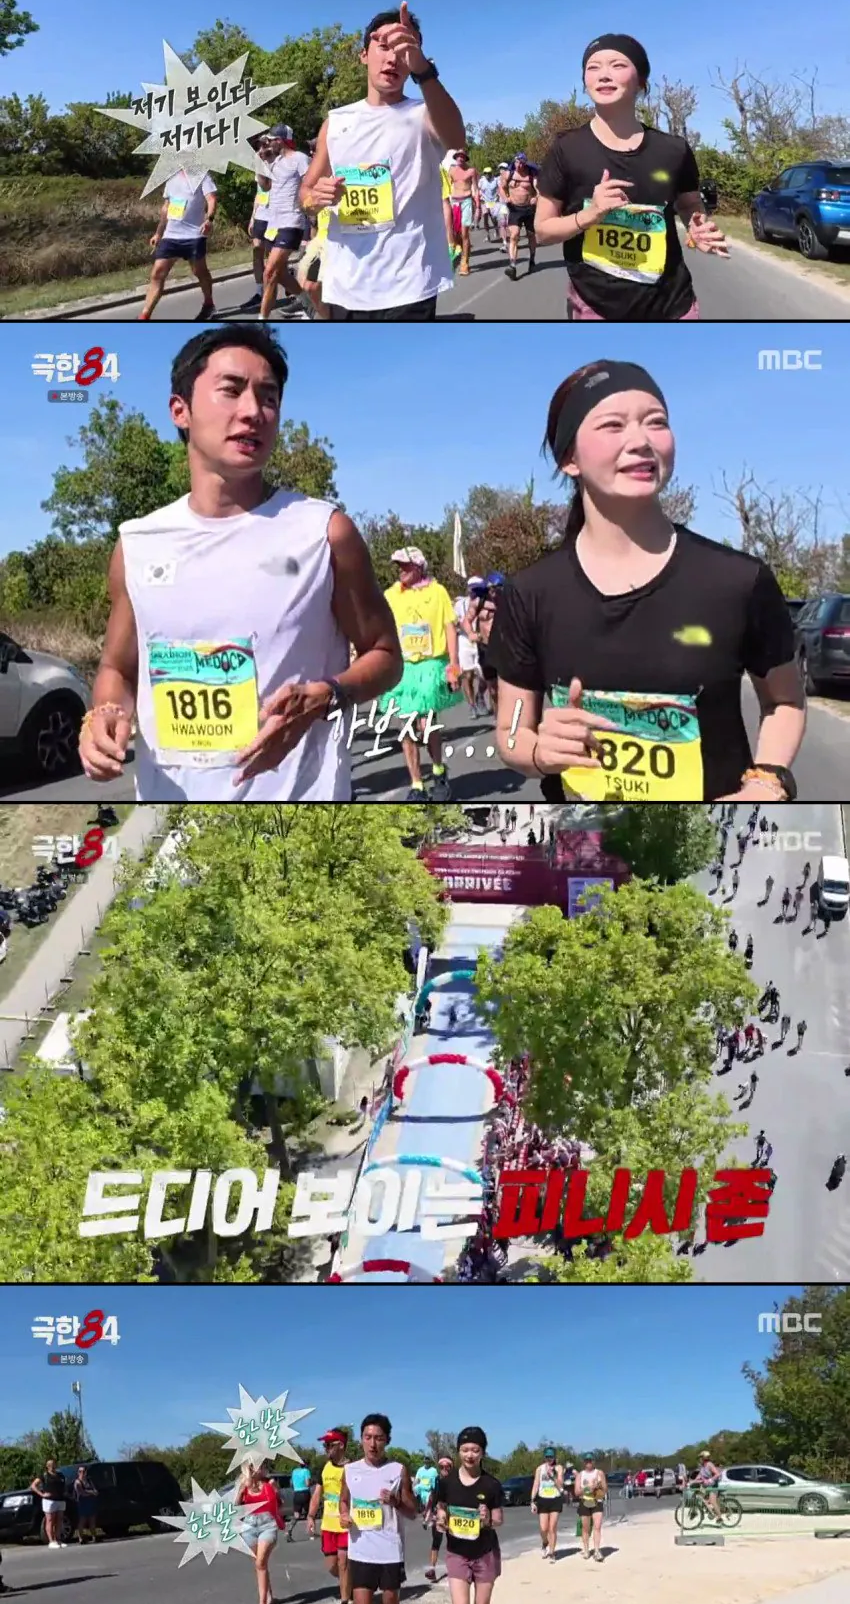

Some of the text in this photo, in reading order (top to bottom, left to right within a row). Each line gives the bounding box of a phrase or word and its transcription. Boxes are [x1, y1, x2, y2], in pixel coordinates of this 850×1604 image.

[345, 188, 379, 208] 1816
[597, 228, 651, 253] 1820
[166, 688, 232, 720] 1816
[172, 723, 233, 736] HWAWOON
[605, 775, 649, 794] TSUKI
[357, 1510, 376, 1519] 1816
[453, 1519, 475, 1528] 1820
